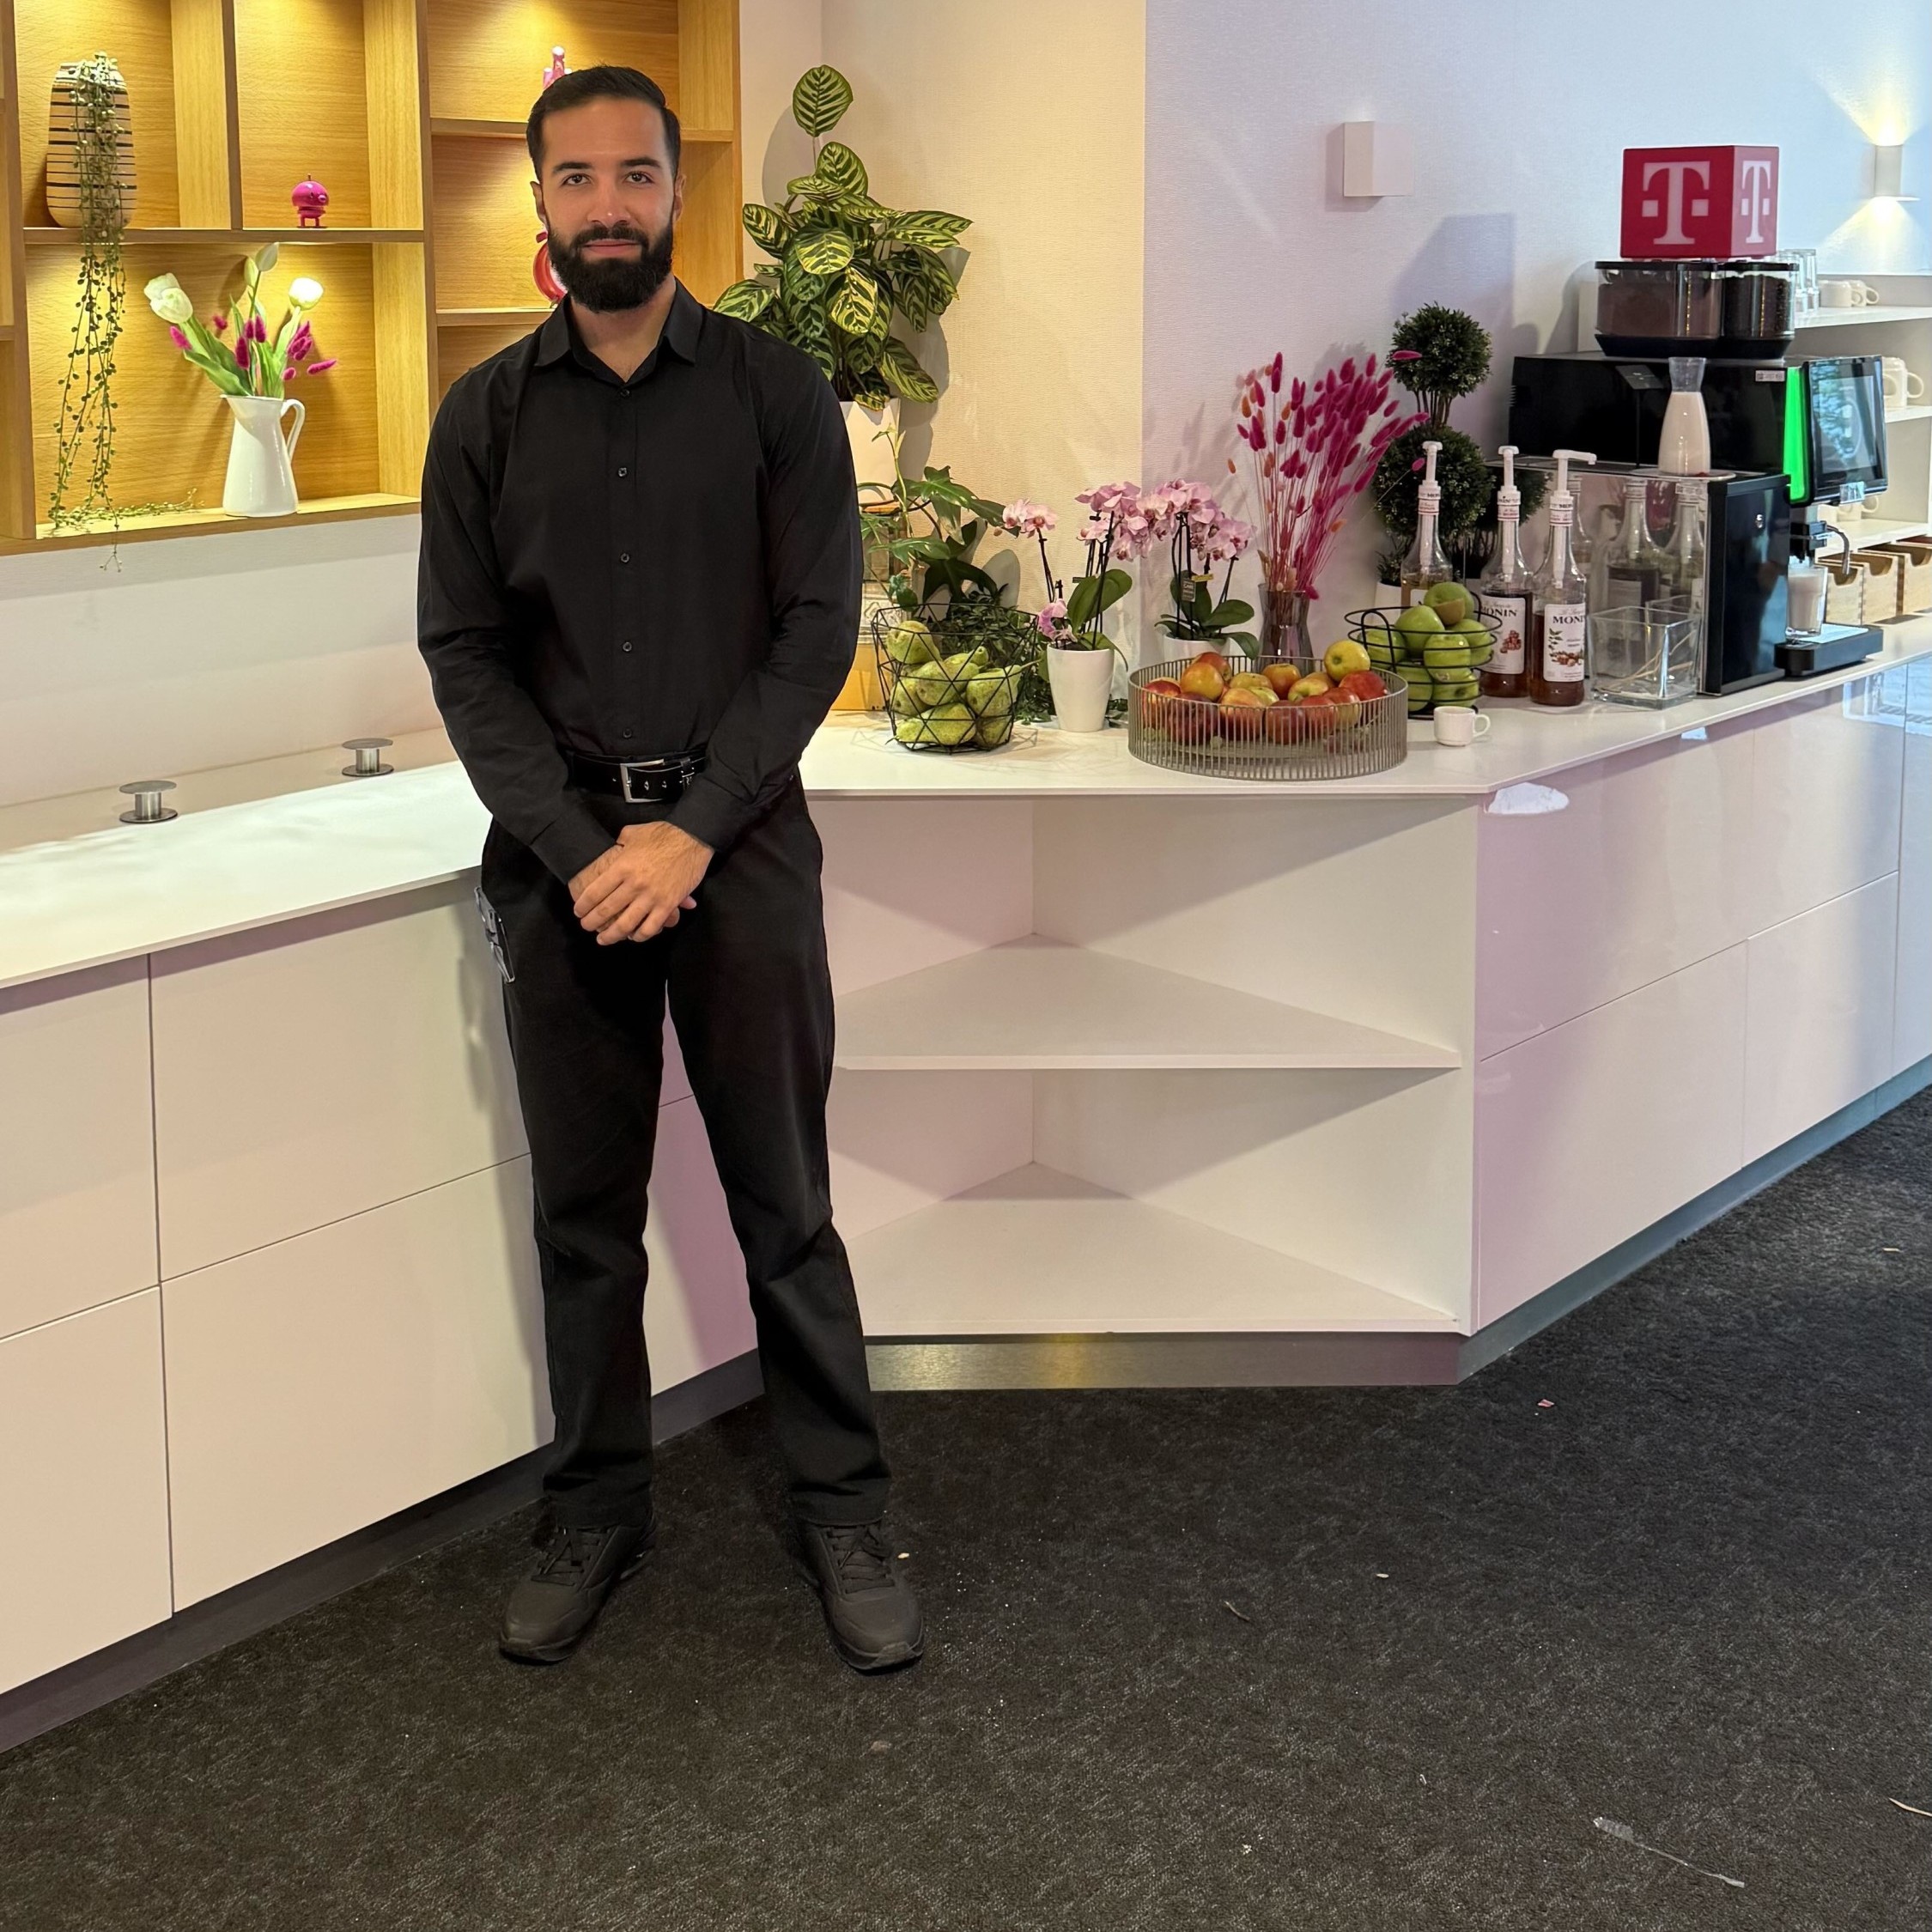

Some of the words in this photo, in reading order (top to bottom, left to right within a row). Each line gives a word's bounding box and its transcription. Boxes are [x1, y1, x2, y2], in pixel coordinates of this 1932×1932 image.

[1642, 161, 1710, 245] T
[1741, 161, 1771, 244] T
[1552, 615, 1584, 624] MONI
